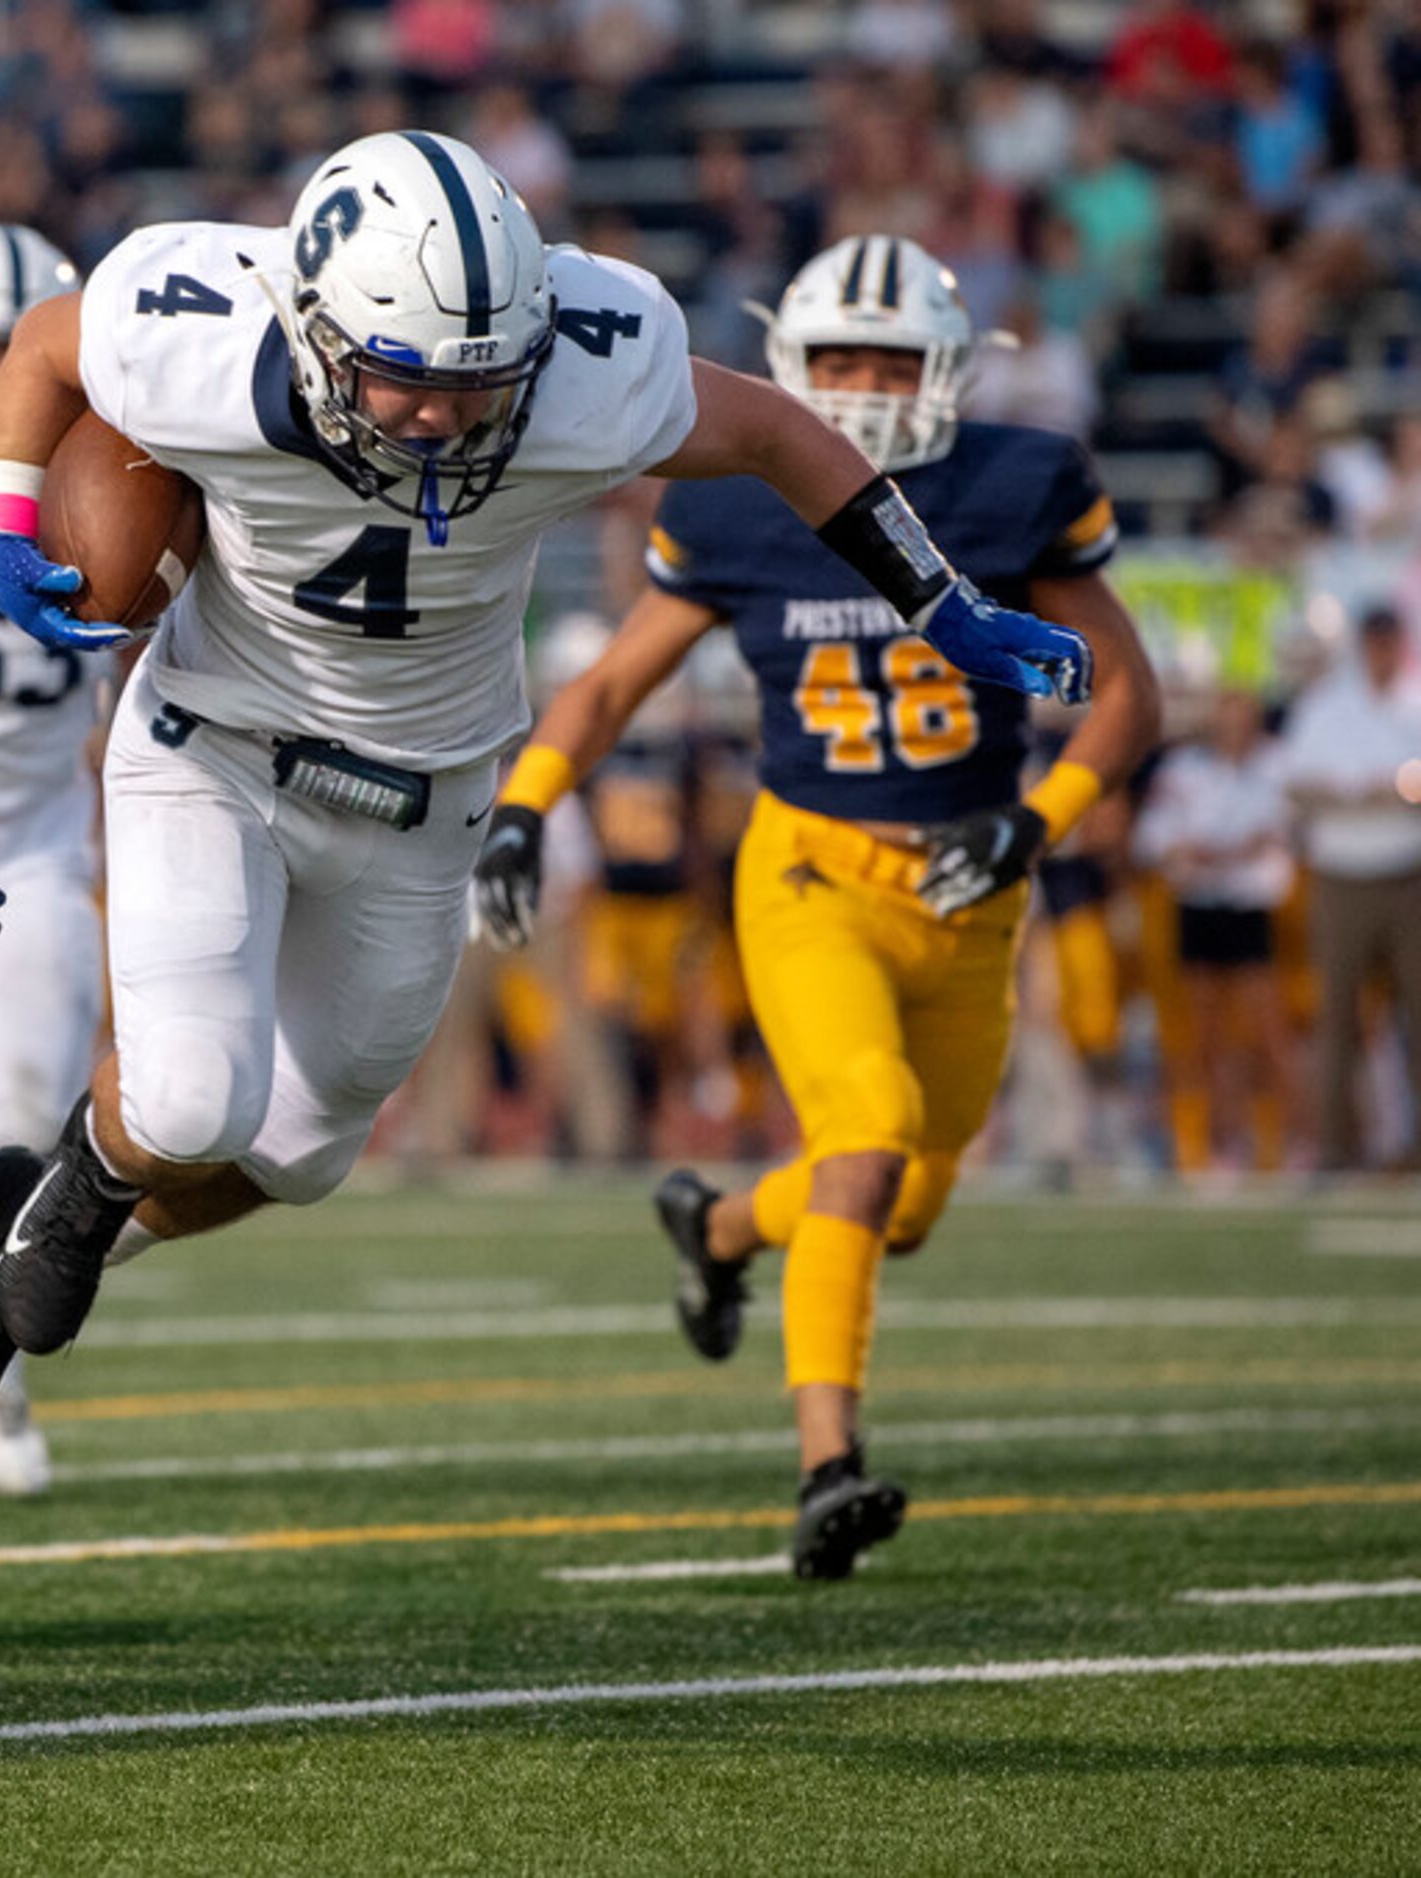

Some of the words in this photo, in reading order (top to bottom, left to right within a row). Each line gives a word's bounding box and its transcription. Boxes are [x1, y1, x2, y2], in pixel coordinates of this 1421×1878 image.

[295, 186, 364, 283] S
[136, 273, 234, 316] 4
[459, 341, 498, 363] PTF
[554, 307, 642, 358] 4
[293, 524, 420, 638] 4
[792, 635, 980, 773] 48
